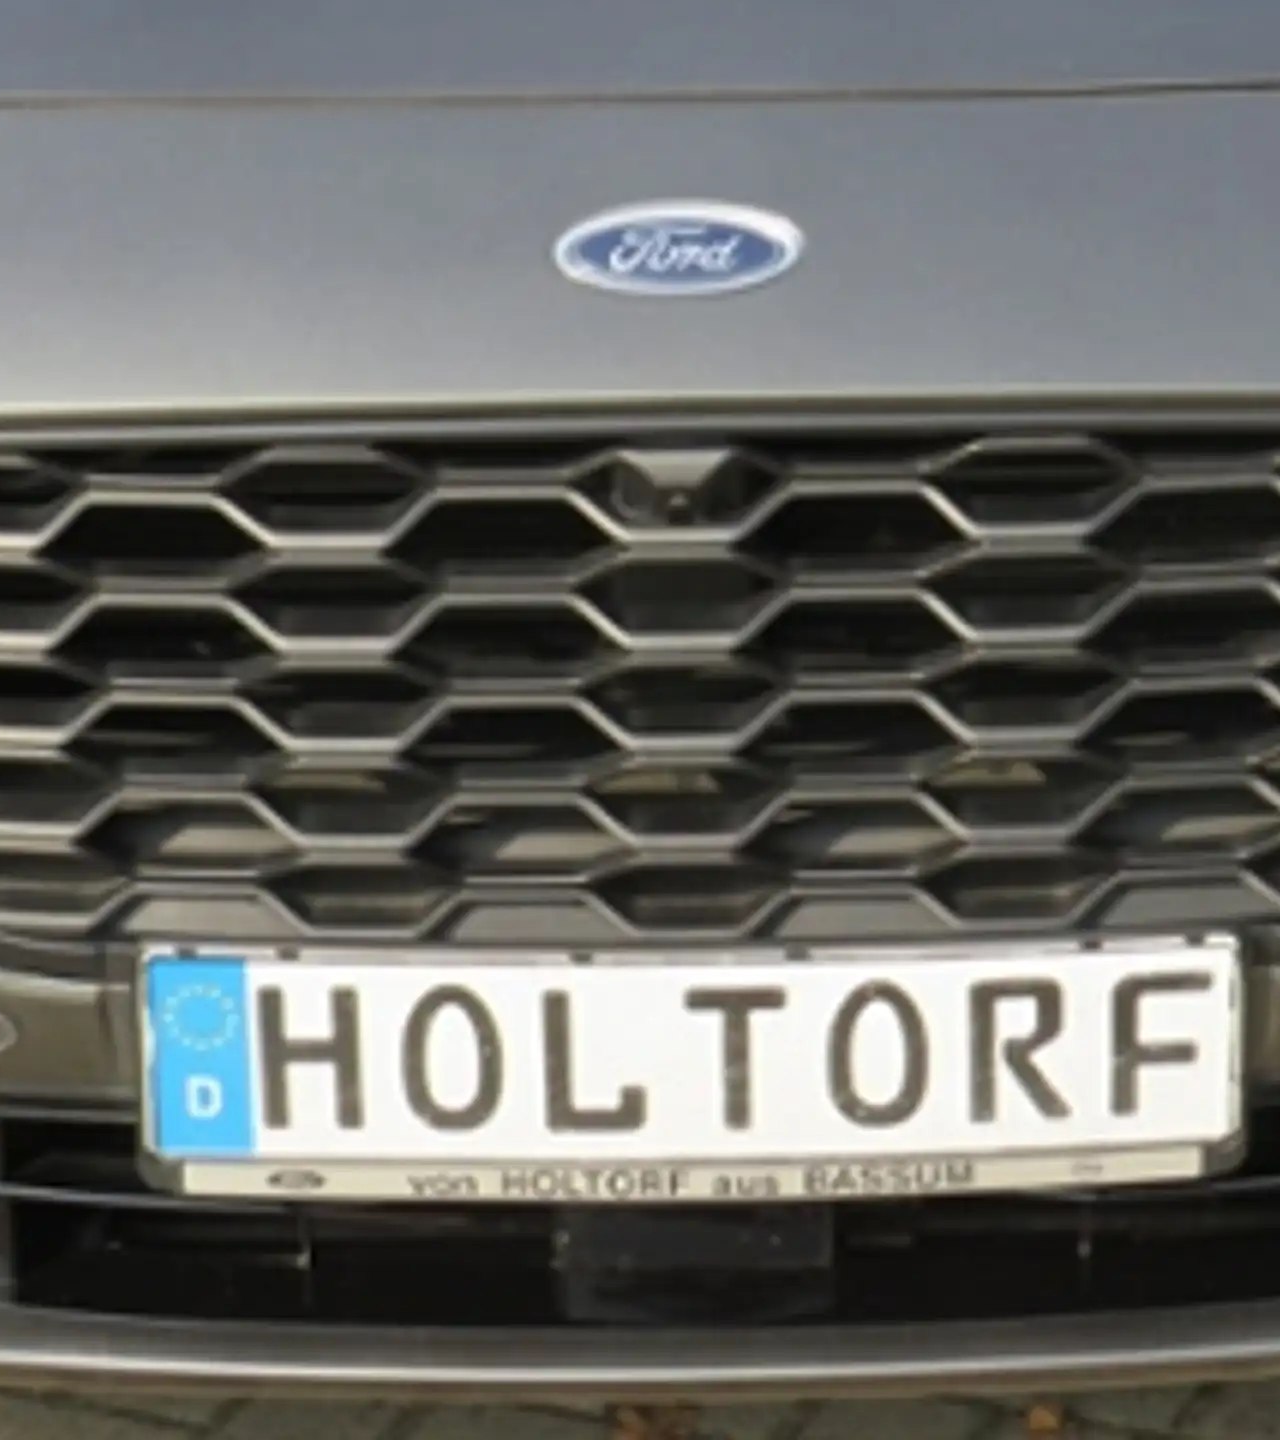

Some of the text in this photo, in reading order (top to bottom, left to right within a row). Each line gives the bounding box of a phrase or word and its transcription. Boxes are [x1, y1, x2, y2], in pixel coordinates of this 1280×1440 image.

[609, 224, 742, 273] Ford
[256, 971, 1214, 1133] HOLTORF
[184, 1074, 223, 1120] D
[406, 1159, 976, 1198] von HOLTORF aus BASSUM
